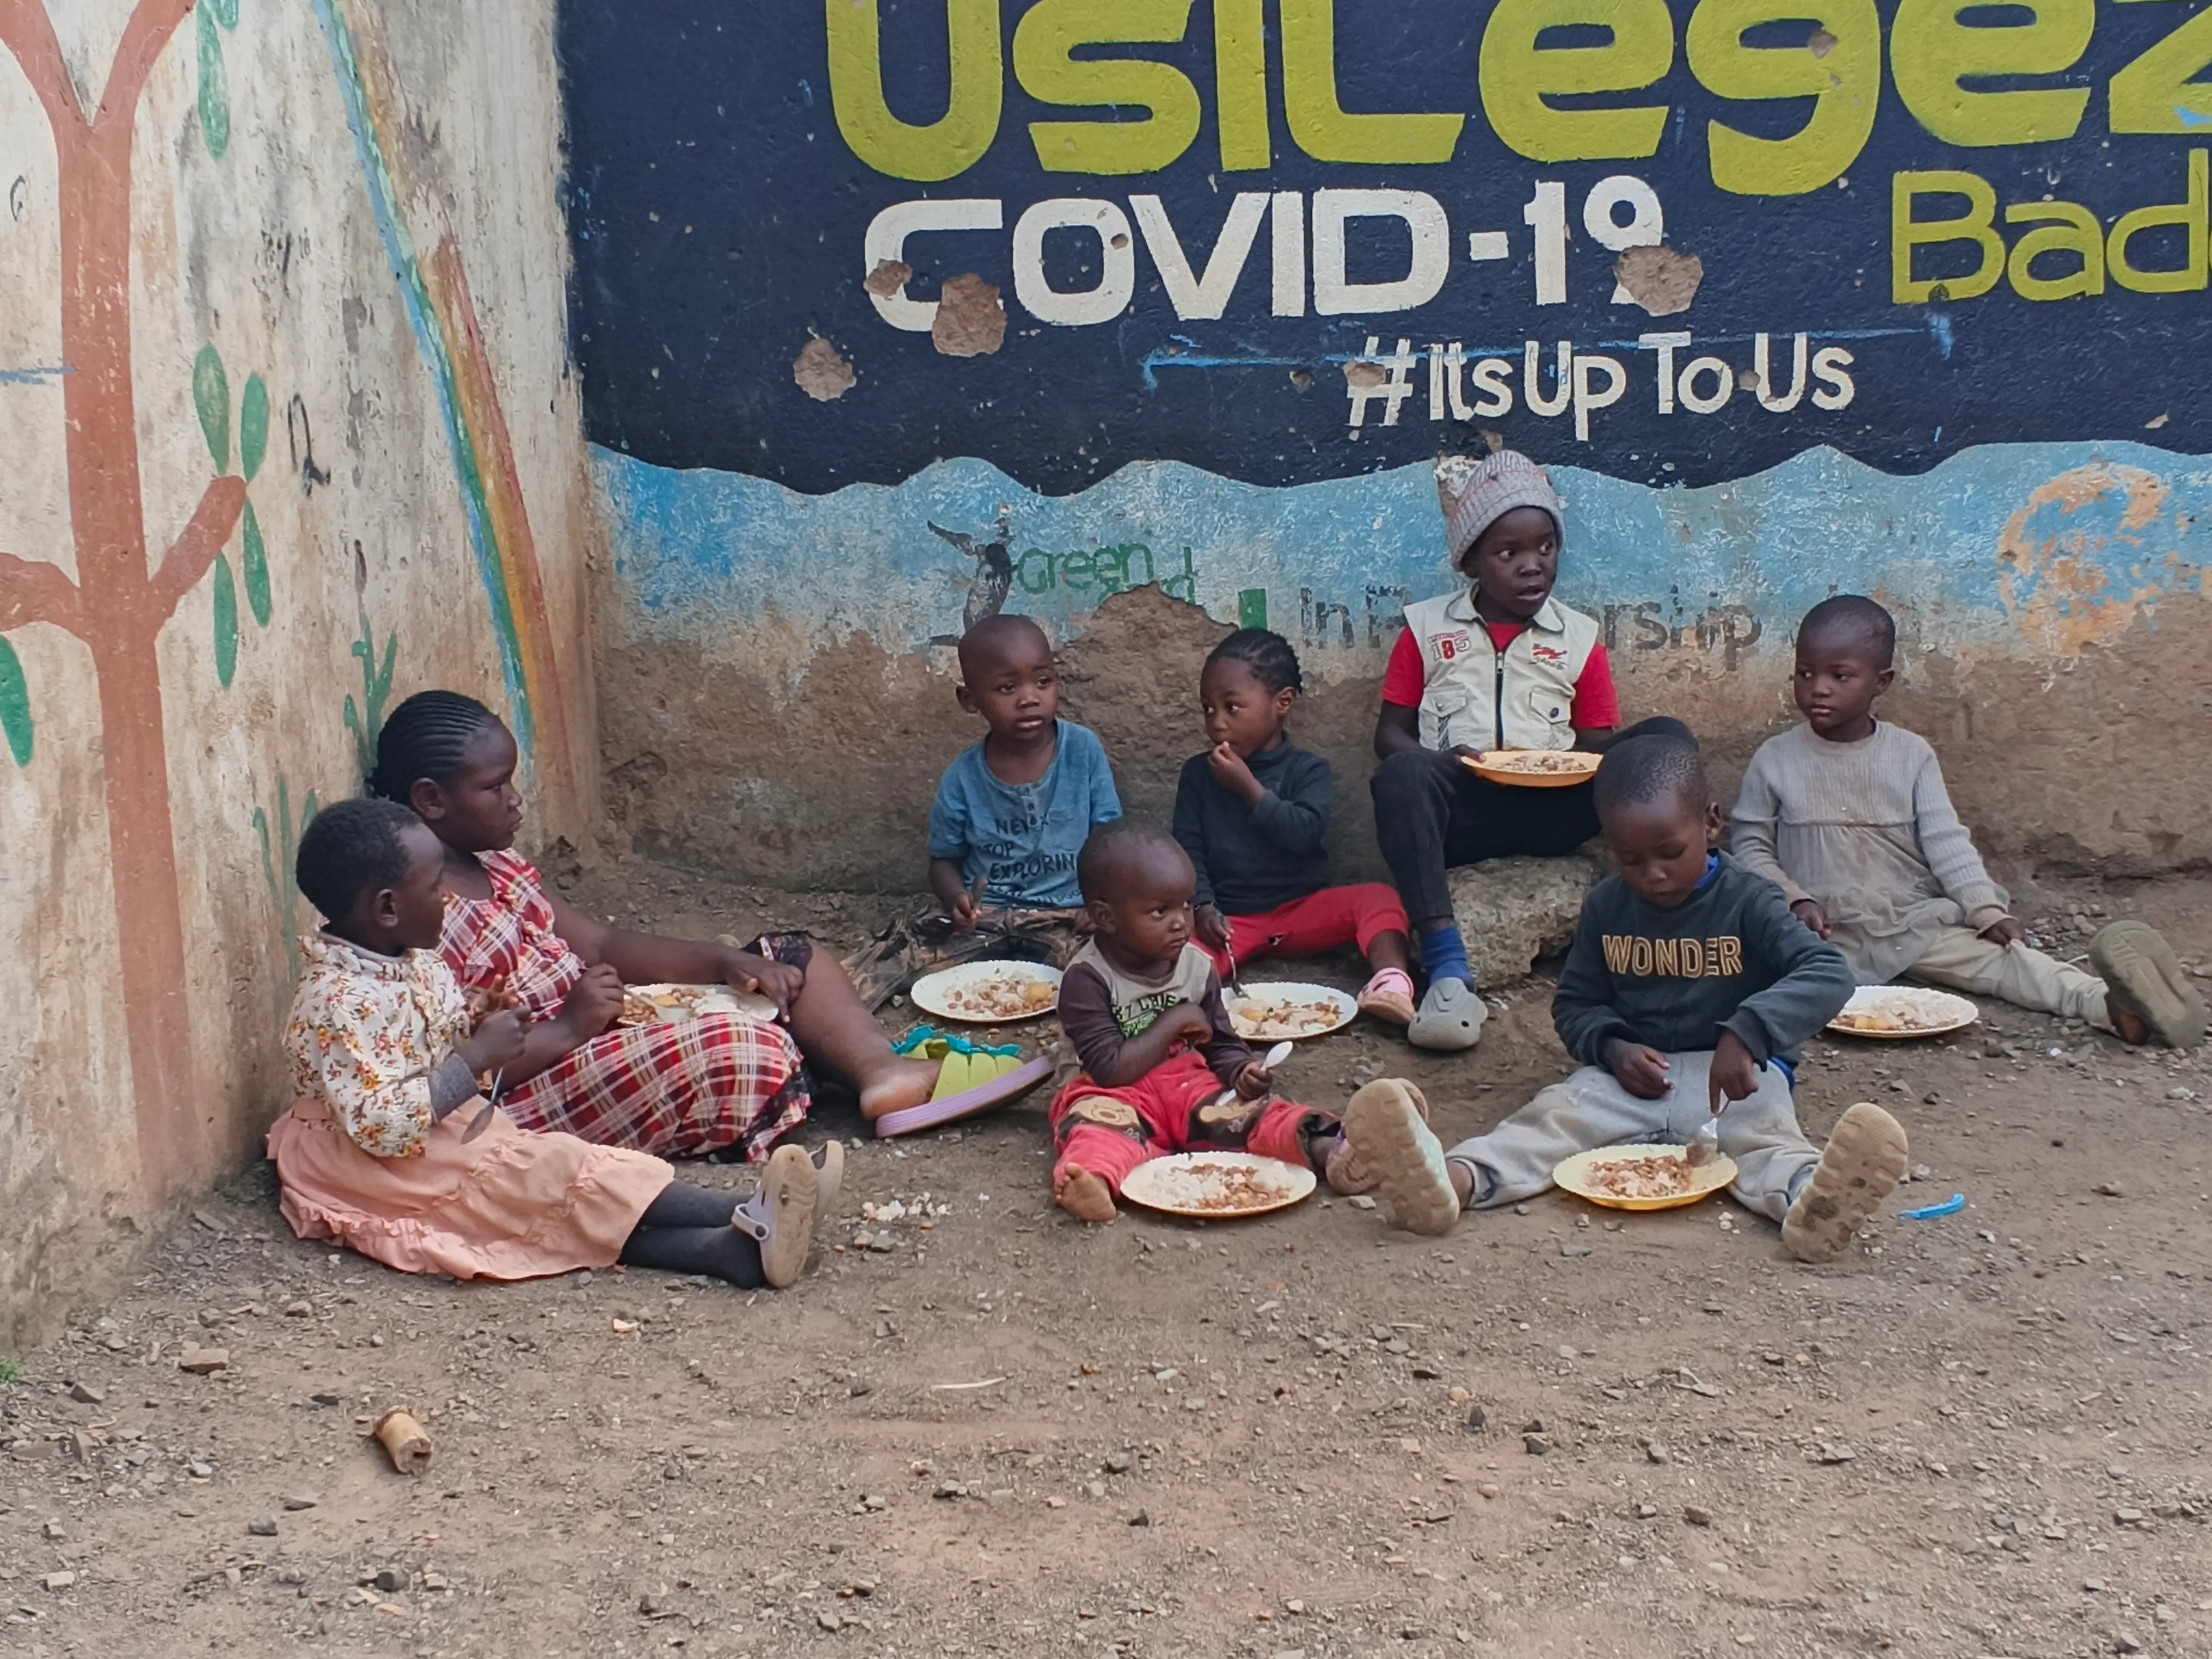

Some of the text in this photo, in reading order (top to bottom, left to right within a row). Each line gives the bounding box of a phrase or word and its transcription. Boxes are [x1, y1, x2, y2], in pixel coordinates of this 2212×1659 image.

[864, 175, 1666, 331] COVID-19
[1892, 148, 2212, 304] Bad
[990, 852, 1076, 881] EXPLORIN
[1602, 935, 1743, 978] WONDER
